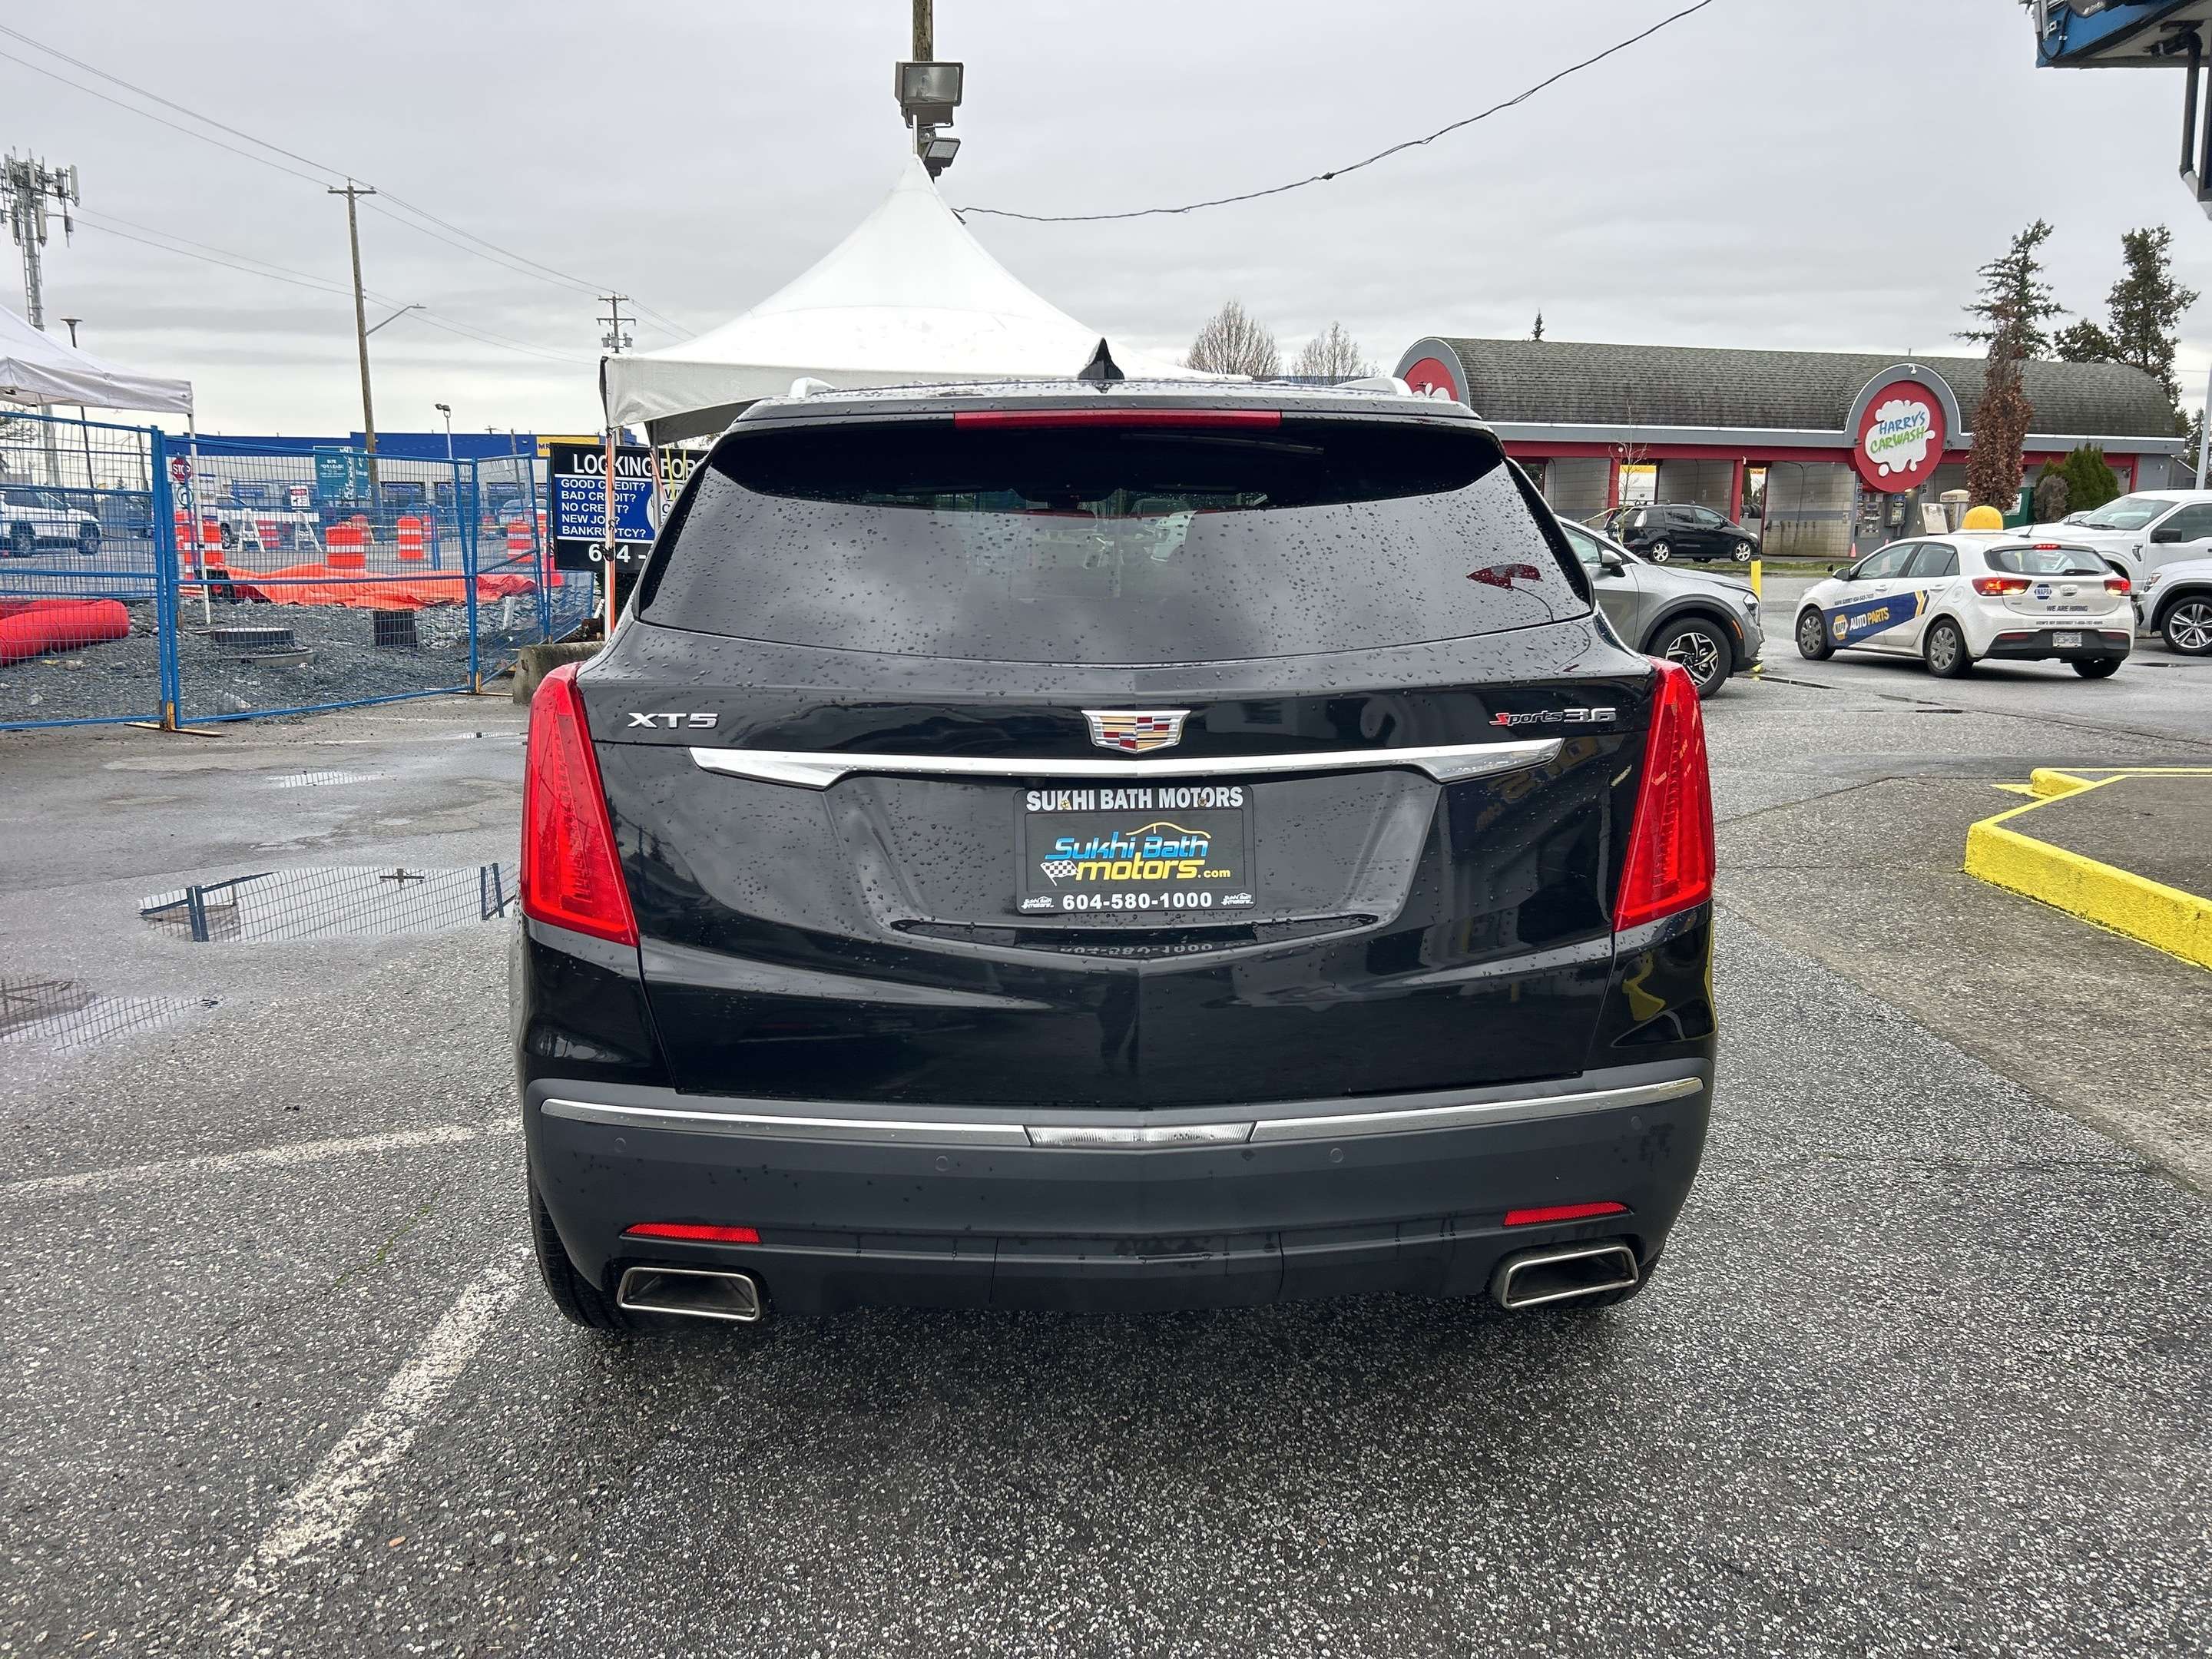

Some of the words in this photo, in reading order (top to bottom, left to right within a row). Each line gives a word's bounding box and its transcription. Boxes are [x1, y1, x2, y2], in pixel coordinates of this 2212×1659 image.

[1879, 411, 1926, 435] HARRY'S
[1869, 427, 1926, 454] CARWASH
[561, 478, 594, 488] GOOD
[598, 480, 646, 492] CEDIT?
[561, 491, 585, 500] BAD
[588, 492, 636, 503] CRDIT?
[561, 502, 578, 512] NO
[581, 503, 629, 514] CRET?
[561, 514, 588, 524] NEW
[590, 515, 621, 525] JO?
[562, 525, 647, 538] BANKRTCY?
[588, 543, 631, 563] 64
[1849, 614, 1867, 631] AUTO
[1867, 607, 1889, 625] PARTS
[628, 712, 719, 729] XT5
[1489, 710, 1563, 726] Sports
[1026, 790, 1094, 811] SUKHI
[1100, 789, 1152, 810] BATH
[1158, 786, 1243, 809] MOTORS
[1045, 831, 1136, 859] Sukhi
[1142, 836, 1209, 858] Bath
[1062, 892, 1212, 910] 604-580-1000
